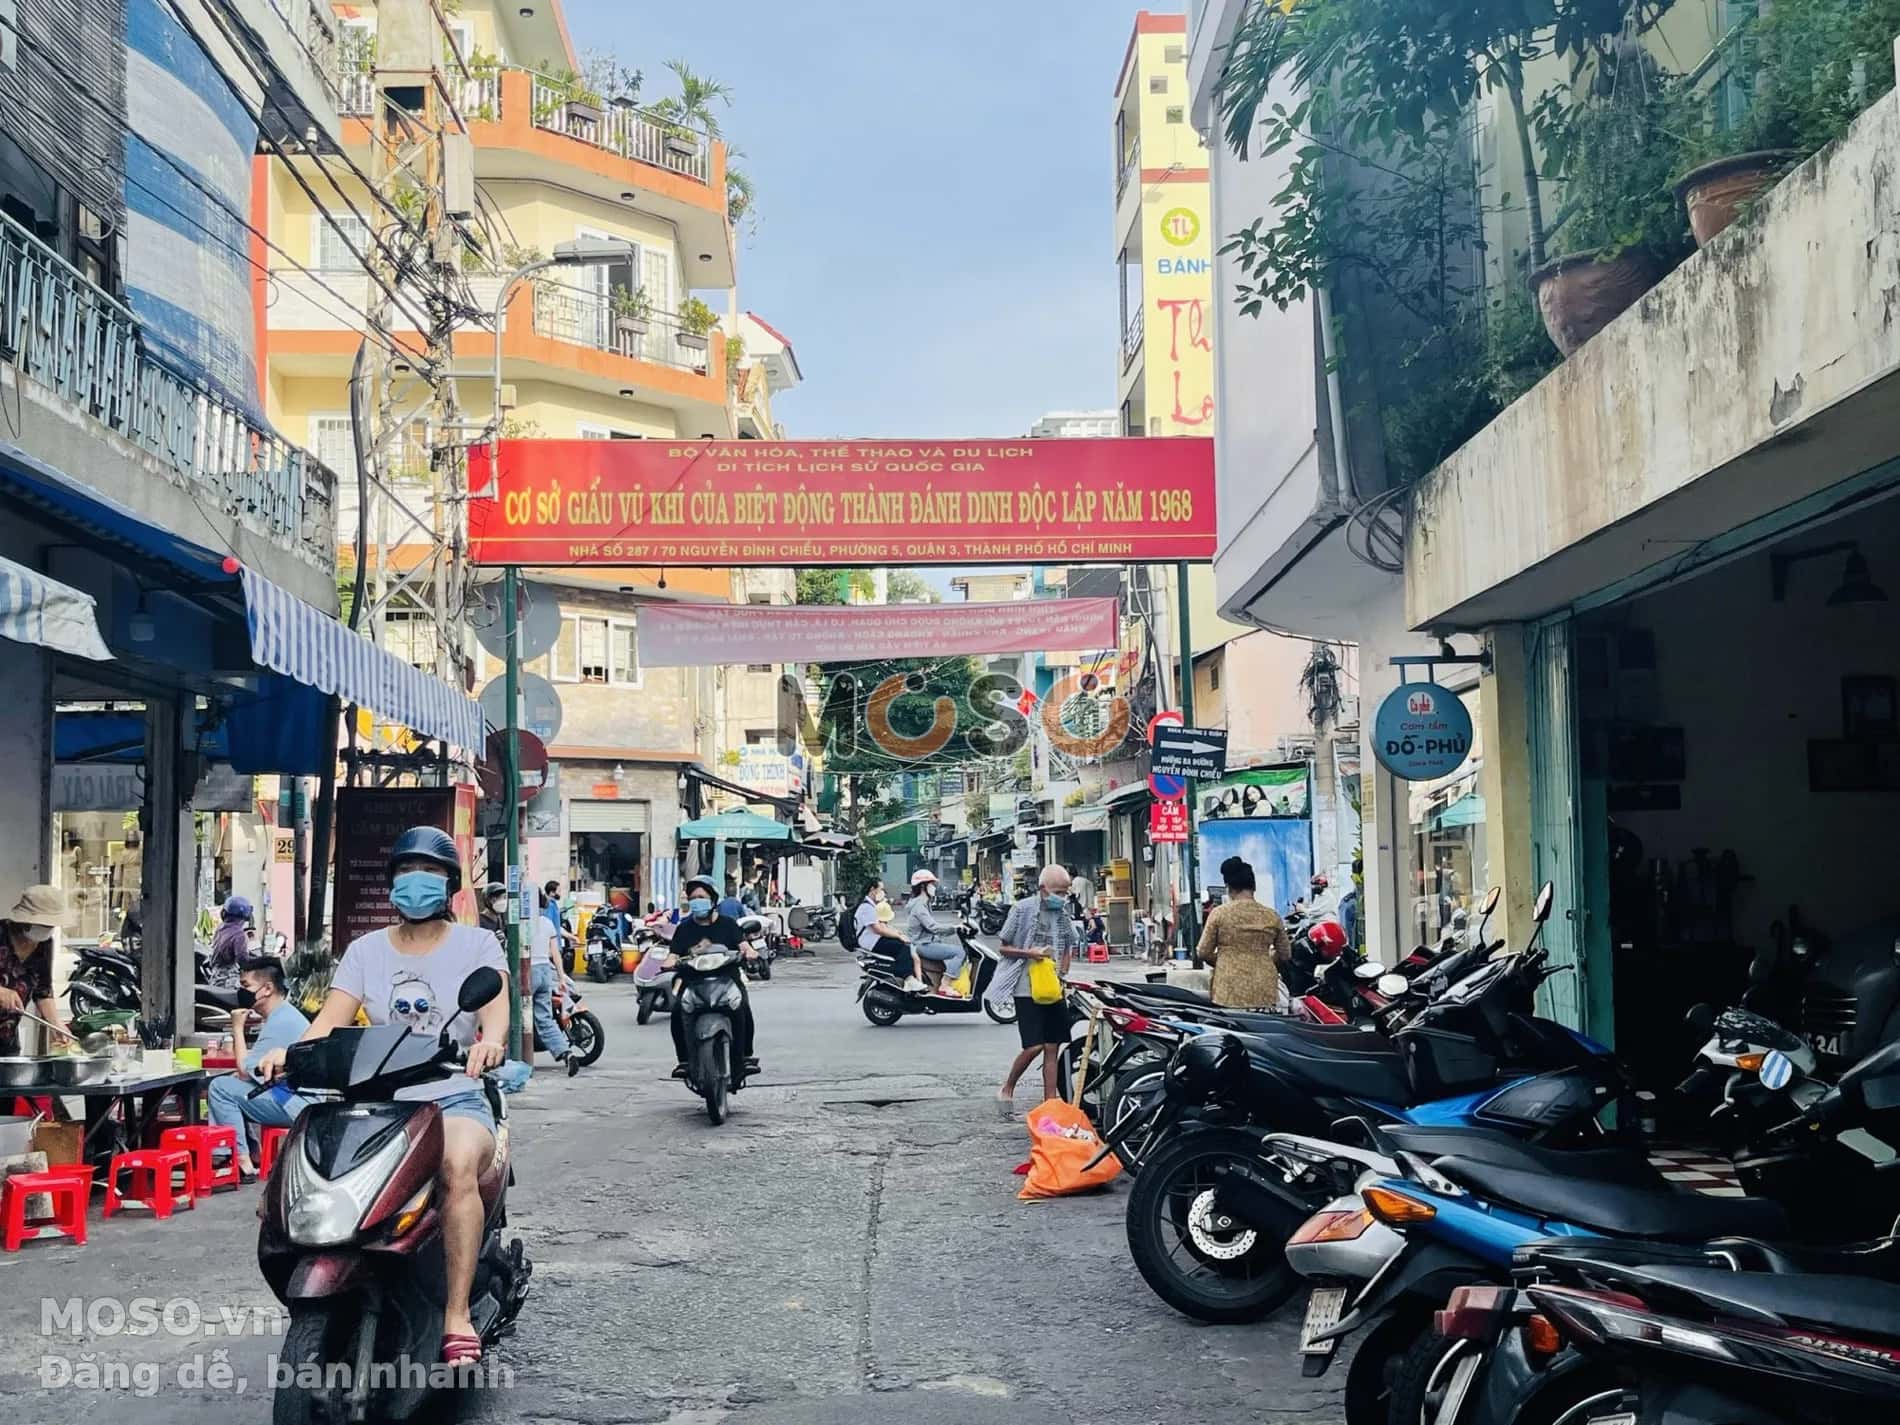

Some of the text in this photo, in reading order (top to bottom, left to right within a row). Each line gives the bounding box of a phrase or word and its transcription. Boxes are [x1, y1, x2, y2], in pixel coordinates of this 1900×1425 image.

[669, 447, 698, 459] BỘ
[705, 447, 747, 458] VĂN
[754, 447, 804, 459] HÓA,
[855, 448, 914, 458] THAO
[919, 446, 945, 458] VÀ
[953, 448, 981, 457] DU
[987, 447, 1033, 459] LỊCH
[717, 460, 985, 473] DI TÍCH LỊCH SỬ QUỐC GIA
[505, 477, 1193, 532] CƠ SỞ GIẤU VŨ KHÍ CỦA BIỆT ĐỘNG THÀNH ĐÁNH DINH ĐỘC LẬP NĂM 1968
[569, 543, 599, 557] NHÀ
[602, 542, 624, 556] SỐ
[627, 545, 651, 556] 287
[652, 545, 658, 556] /
[662, 545, 677, 556] 70
[743, 543, 776, 556] ĐÌNH
[830, 543, 888, 556] PHƯỜNG
[891, 545, 903, 557] 5,
[907, 543, 946, 557] QUẬN
[949, 545, 961, 557] 3,
[966, 542, 1011, 555] THÀNH
[1015, 541, 1044, 555] PHỐ
[1048, 541, 1068, 554] HỒ
[1071, 542, 1095, 554] CHÍ
[1098, 543, 1133, 554] MINH
